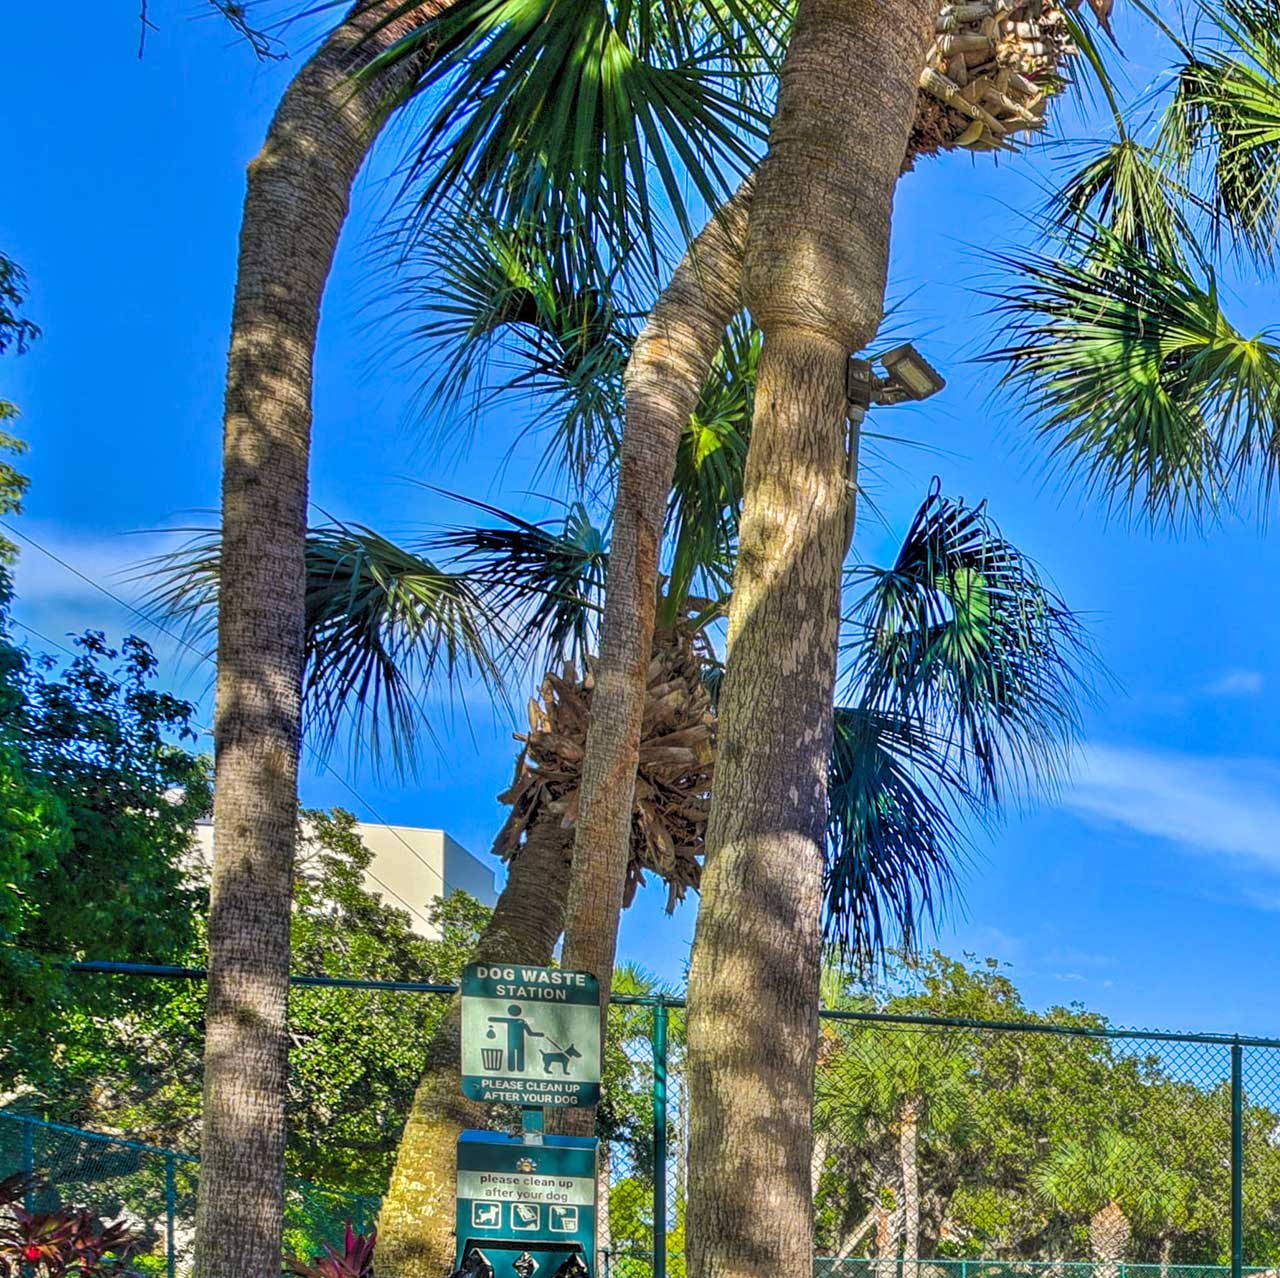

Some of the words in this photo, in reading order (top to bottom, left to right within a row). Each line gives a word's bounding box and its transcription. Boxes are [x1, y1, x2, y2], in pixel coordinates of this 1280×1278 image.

[477, 966, 515, 981] DOG
[521, 970, 586, 987] WASTE
[496, 984, 566, 1000] STATION
[481, 1079, 524, 1091] PLEASE
[526, 1081, 562, 1093] CLEAN
[564, 1084, 580, 1094] UP
[483, 1091, 520, 1103] AFTER
[522, 1093, 552, 1104] YOUR
[554, 1095, 578, 1105] DOG
[480, 1173, 520, 1185] please
[523, 1175, 555, 1188] clean
[558, 1179, 574, 1190] up
[485, 1186, 513, 1198] after
[516, 1189, 544, 1200] your
[546, 1190, 568, 1203] dog
